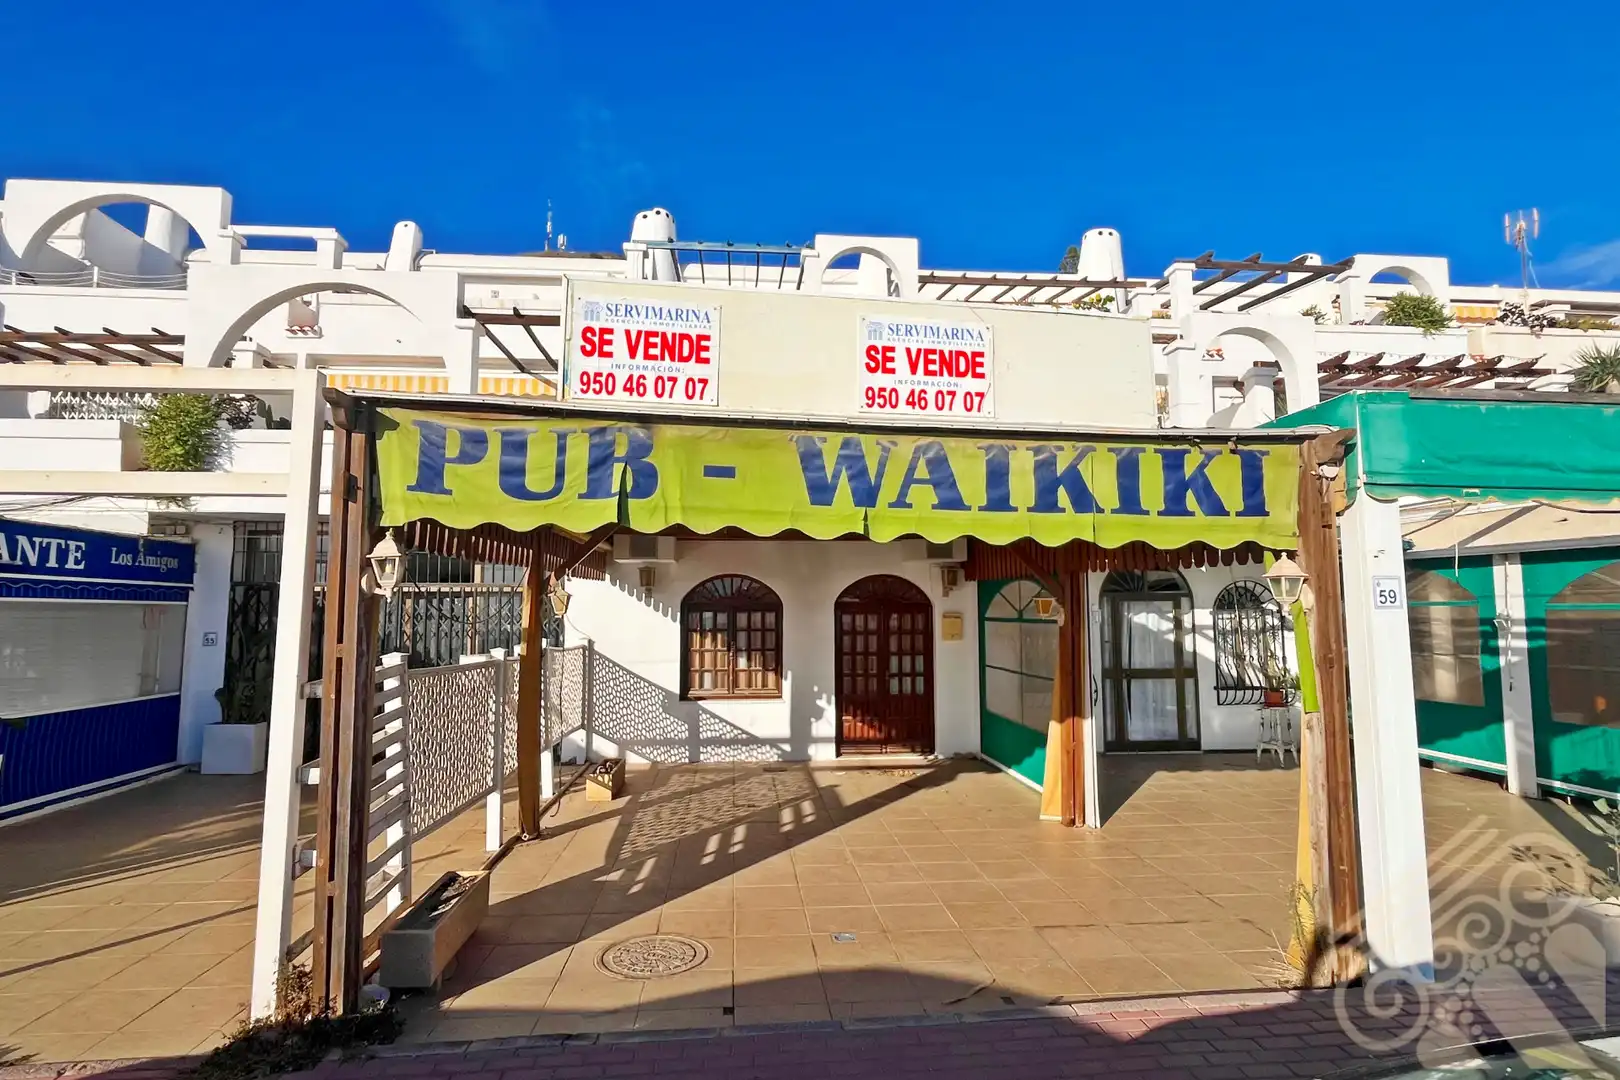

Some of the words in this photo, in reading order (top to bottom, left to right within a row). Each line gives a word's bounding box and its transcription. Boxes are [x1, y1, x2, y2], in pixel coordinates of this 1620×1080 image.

[605, 302, 711, 323] SERVIMARINA
[580, 326, 614, 358] SE
[624, 329, 711, 364] VENDE
[887, 323, 985, 342] SERVIMARINA
[865, 344, 896, 375] SE
[905, 347, 986, 379] VENDE
[579, 371, 616, 395] 950
[623, 373, 647, 397] 46
[654, 375, 678, 399] 07
[685, 377, 709, 400] 07
[865, 386, 899, 409] 950
[905, 388, 928, 411] 46
[934, 389, 957, 411] 07
[963, 391, 985, 413] 07
[406, 420, 659, 501] PUB
[702, 464, 737, 480] -
[788, 434, 1270, 517] WAIKIKI
[110, 547, 133, 566] Los
[135, 550, 179, 573] Amigos
[1379, 589, 1397, 604] 59
